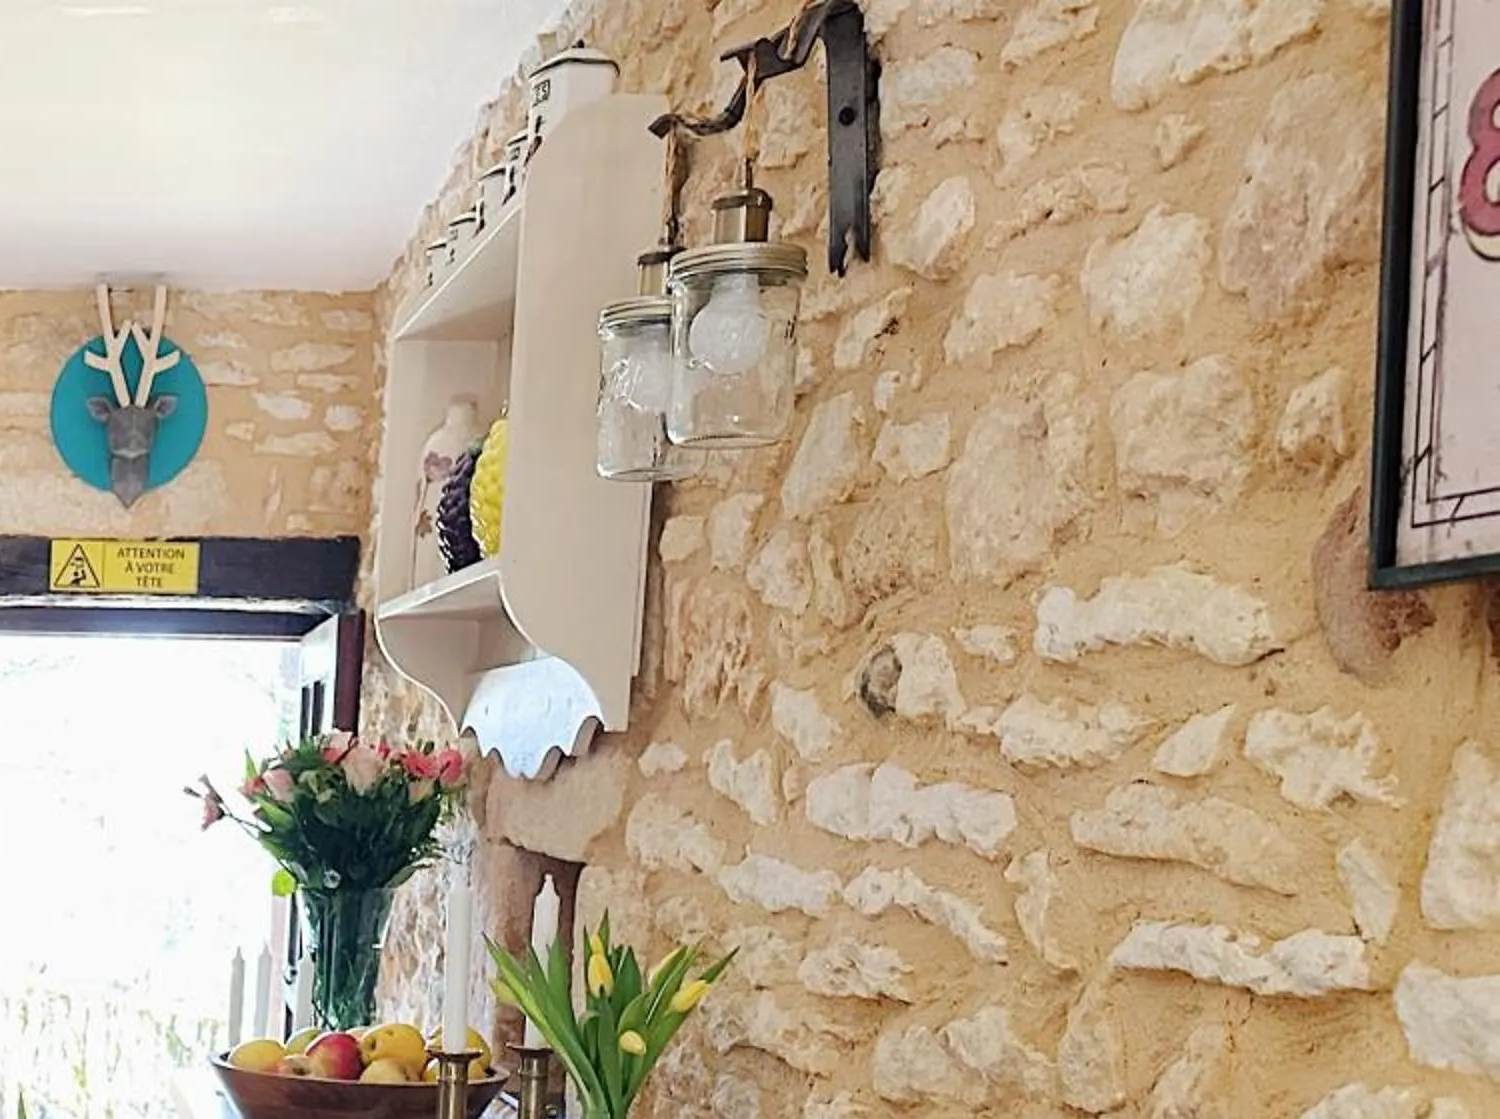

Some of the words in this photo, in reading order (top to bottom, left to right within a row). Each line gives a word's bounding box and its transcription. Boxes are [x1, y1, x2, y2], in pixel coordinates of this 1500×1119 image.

[116, 547, 185, 560] ATTENTION
[125, 562, 134, 574] À
[136, 563, 174, 574] VOTRE
[135, 575, 163, 588] TÊTE
